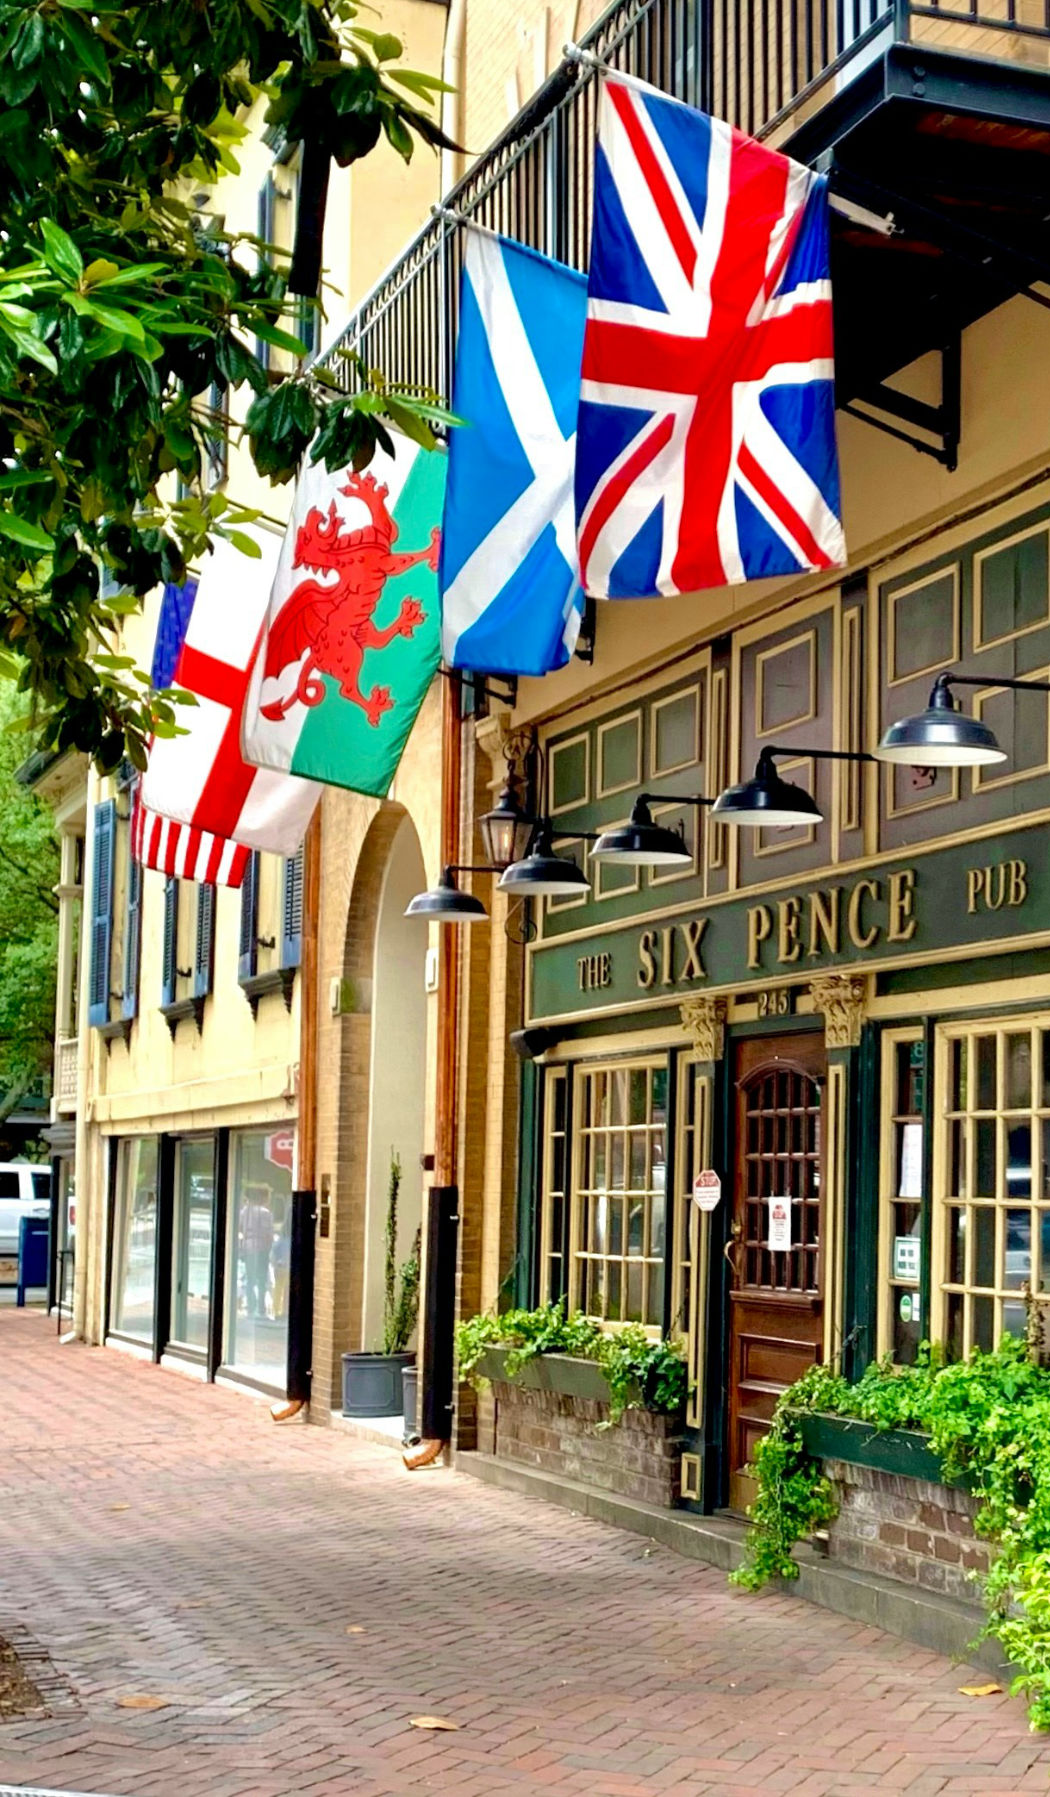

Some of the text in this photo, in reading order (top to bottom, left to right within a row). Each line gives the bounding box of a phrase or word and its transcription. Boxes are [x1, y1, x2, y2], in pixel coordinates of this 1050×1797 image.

[577, 859, 1027, 991] THE SIX PENCE PUB
[759, 990, 788, 1016] 245
